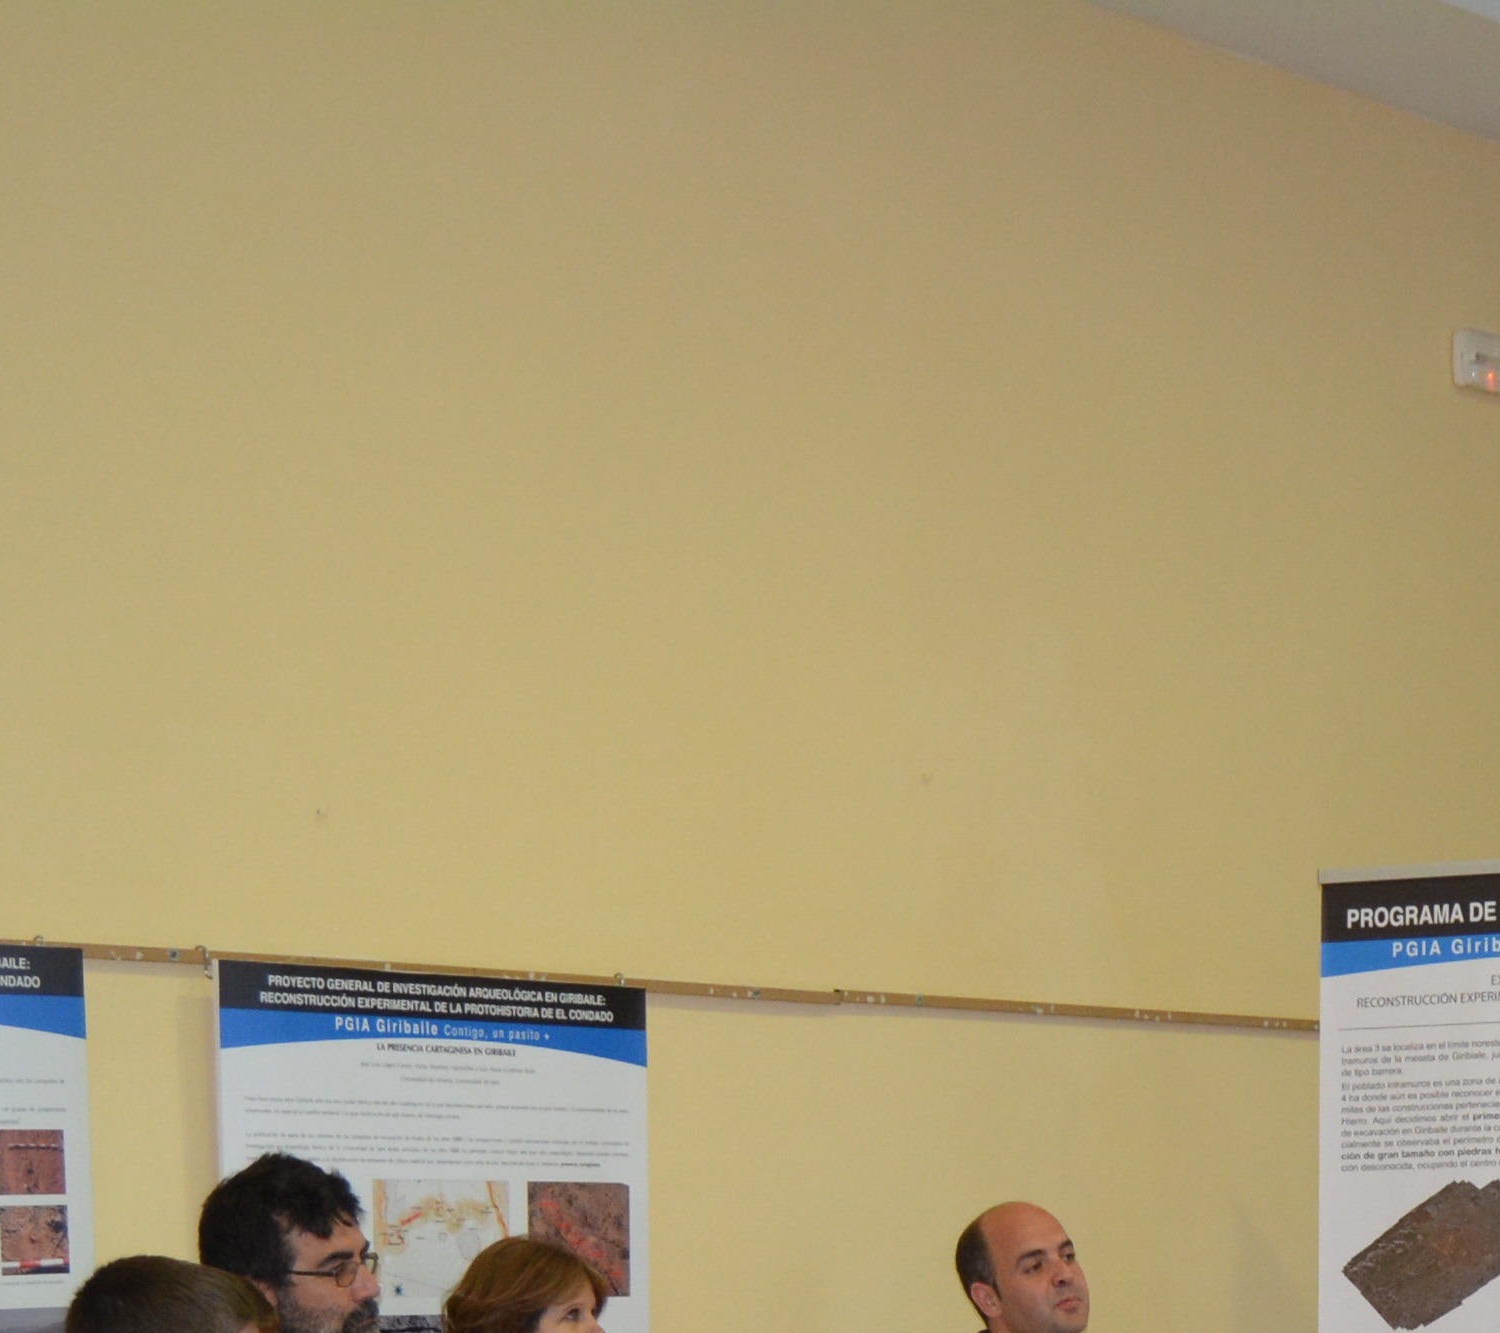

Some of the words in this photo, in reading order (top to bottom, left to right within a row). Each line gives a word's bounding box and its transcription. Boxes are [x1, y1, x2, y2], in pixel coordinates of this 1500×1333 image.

[1347, 903, 1464, 928] PROGRAMA
[1469, 900, 1497, 922] DE
[1392, 940, 1441, 958] PGIA
[268, 975, 325, 990] PROYECTO
[326, 978, 375, 993] GENERAL
[376, 981, 391, 994] DE
[392, 982, 467, 998] INVESTIGACIÓN
[468, 986, 543, 1002] ARQUEOLÓGICA
[544, 990, 558, 1003] EN
[558, 991, 606, 1006] GIRIBAILE:
[1356, 993, 1457, 1008] RECONSTRUCCIÓN
[260, 991, 355, 1009] RECONSTRUCCIÓN
[357, 997, 432, 1013] EXPERIMENTAL
[434, 1001, 448, 1014] DE
[449, 1002, 462, 1014] LA
[464, 1002, 540, 1018] PROTOHISTORIA
[540, 1006, 554, 1019] DE
[555, 1007, 567, 1020] EL
[568, 1008, 614, 1022] CONDADO
[335, 1016, 370, 1032] PGIA
[376, 1018, 438, 1036] Giribaile
[444, 1024, 487, 1040] Contigo,
[493, 1029, 504, 1039] un
[509, 1028, 540, 1042] pasito
[376, 1043, 385, 1052] LA
[387, 1044, 424, 1053] PRESENCIA
[425, 1045, 472, 1055] CARTAGINESA
[473, 1047, 483, 1055] EN
[484, 1048, 516, 1057] GIRIBAILE
